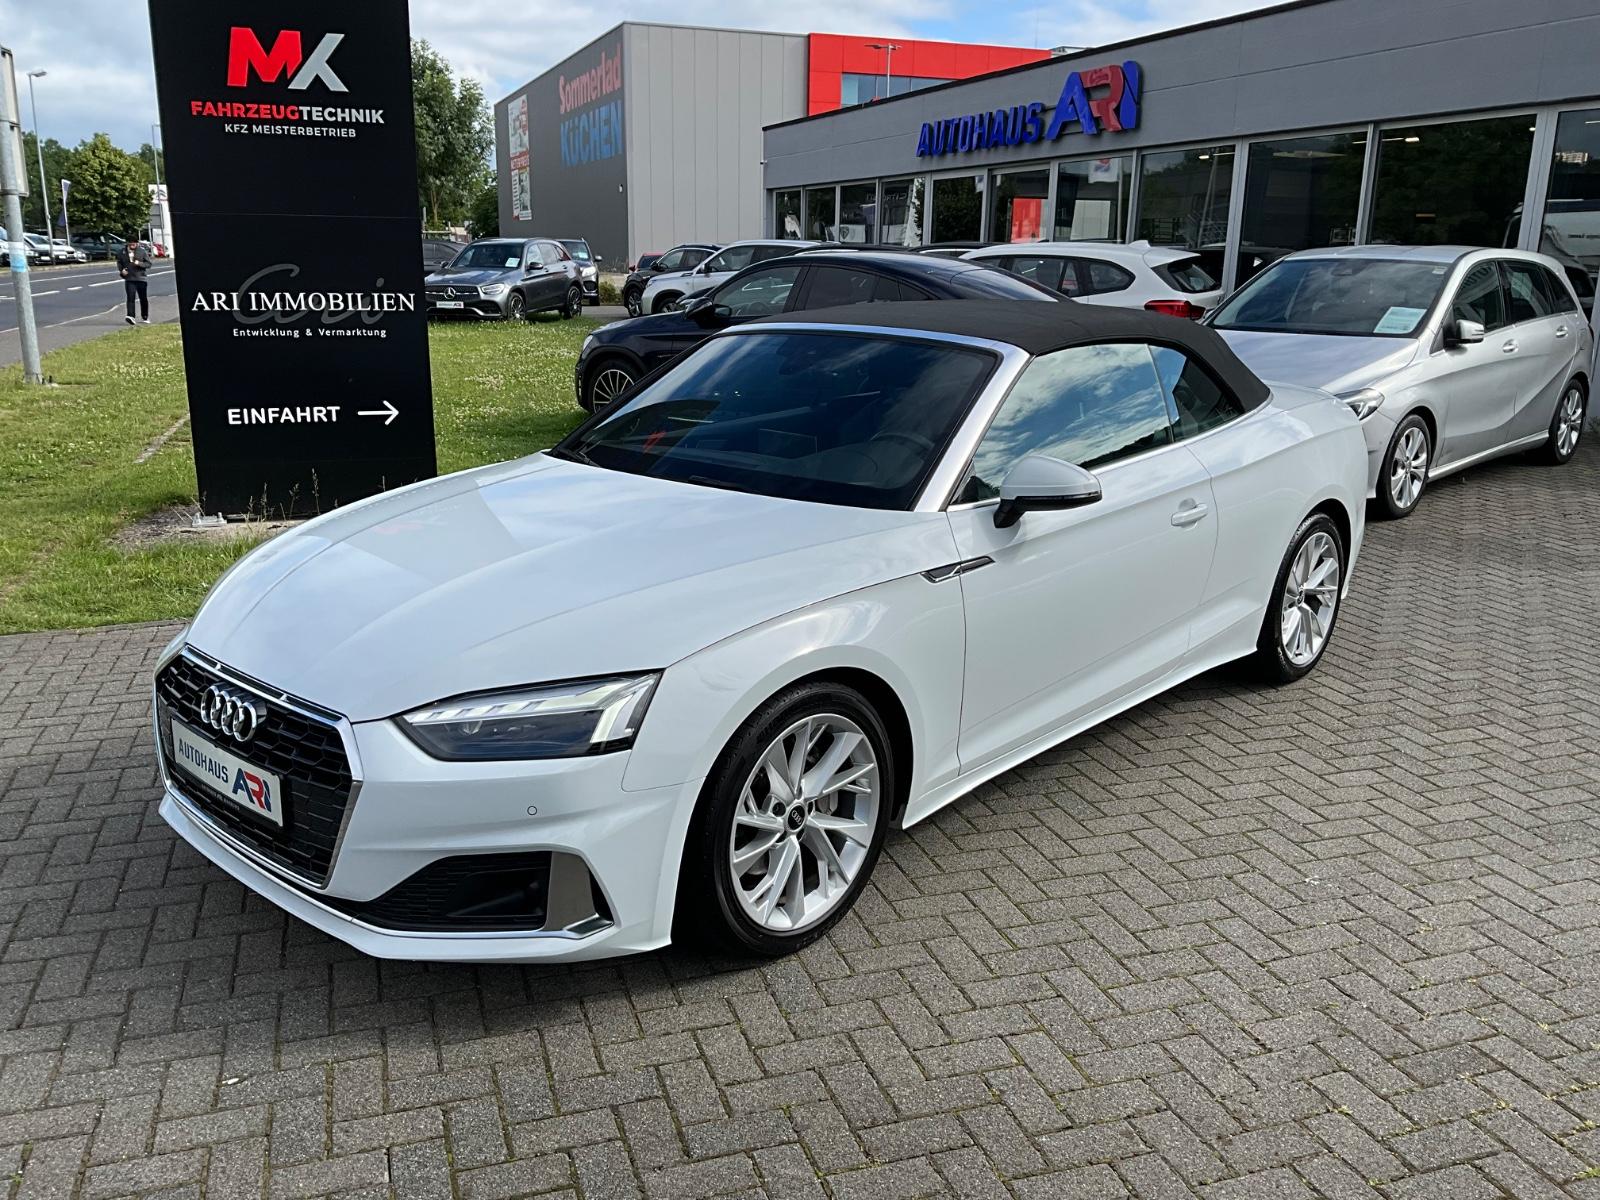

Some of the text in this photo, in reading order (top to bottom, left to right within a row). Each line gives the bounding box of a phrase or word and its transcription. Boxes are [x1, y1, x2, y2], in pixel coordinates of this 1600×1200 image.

[227, 26, 349, 92] MK
[559, 43, 622, 114] Sommerlad
[190, 101, 385, 124] FAHRZEUGTECHNIK
[916, 60, 1140, 157] AUTOHAUS ARI
[224, 123, 356, 138] KFZ MEISTERBETRIEB
[191, 292, 416, 312] ARI IMMOBILIEN
[233, 328, 387, 338] Entwicklung & Vermarktung
[227, 406, 341, 425] EINFAHRT
[178, 738, 229, 784] AUTOHAUS
[232, 767, 272, 813] ARI
